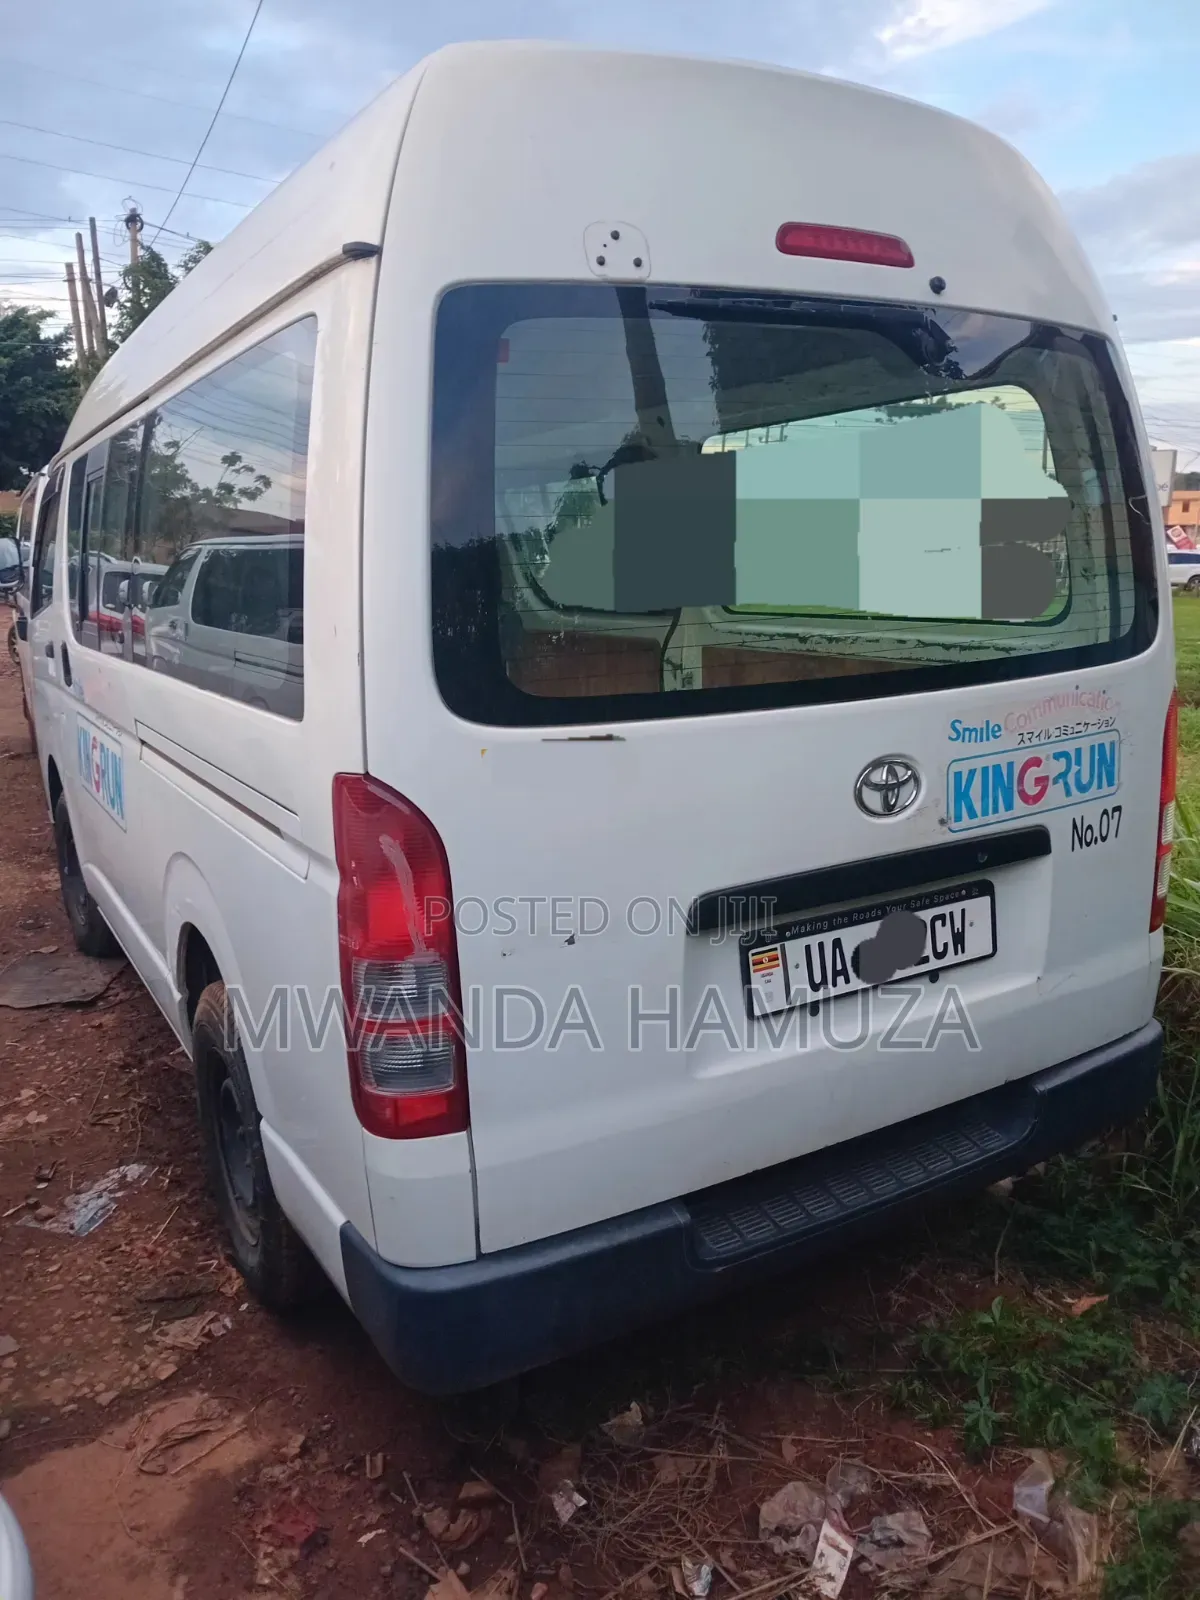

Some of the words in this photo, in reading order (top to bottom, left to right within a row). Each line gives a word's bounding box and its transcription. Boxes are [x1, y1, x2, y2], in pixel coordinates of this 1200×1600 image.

[948, 719, 1002, 743] Smile
[953, 740, 1116, 823] KINGRUN
[1071, 805, 1123, 852] No.07
[791, 921, 828, 935] Making
[833, 915, 848, 926] the
[852, 908, 882, 922] Roads
[885, 903, 907, 913] Your
[910, 896, 930, 908] Safe
[933, 891, 960, 903] Space
[804, 908, 966, 992] UACW
